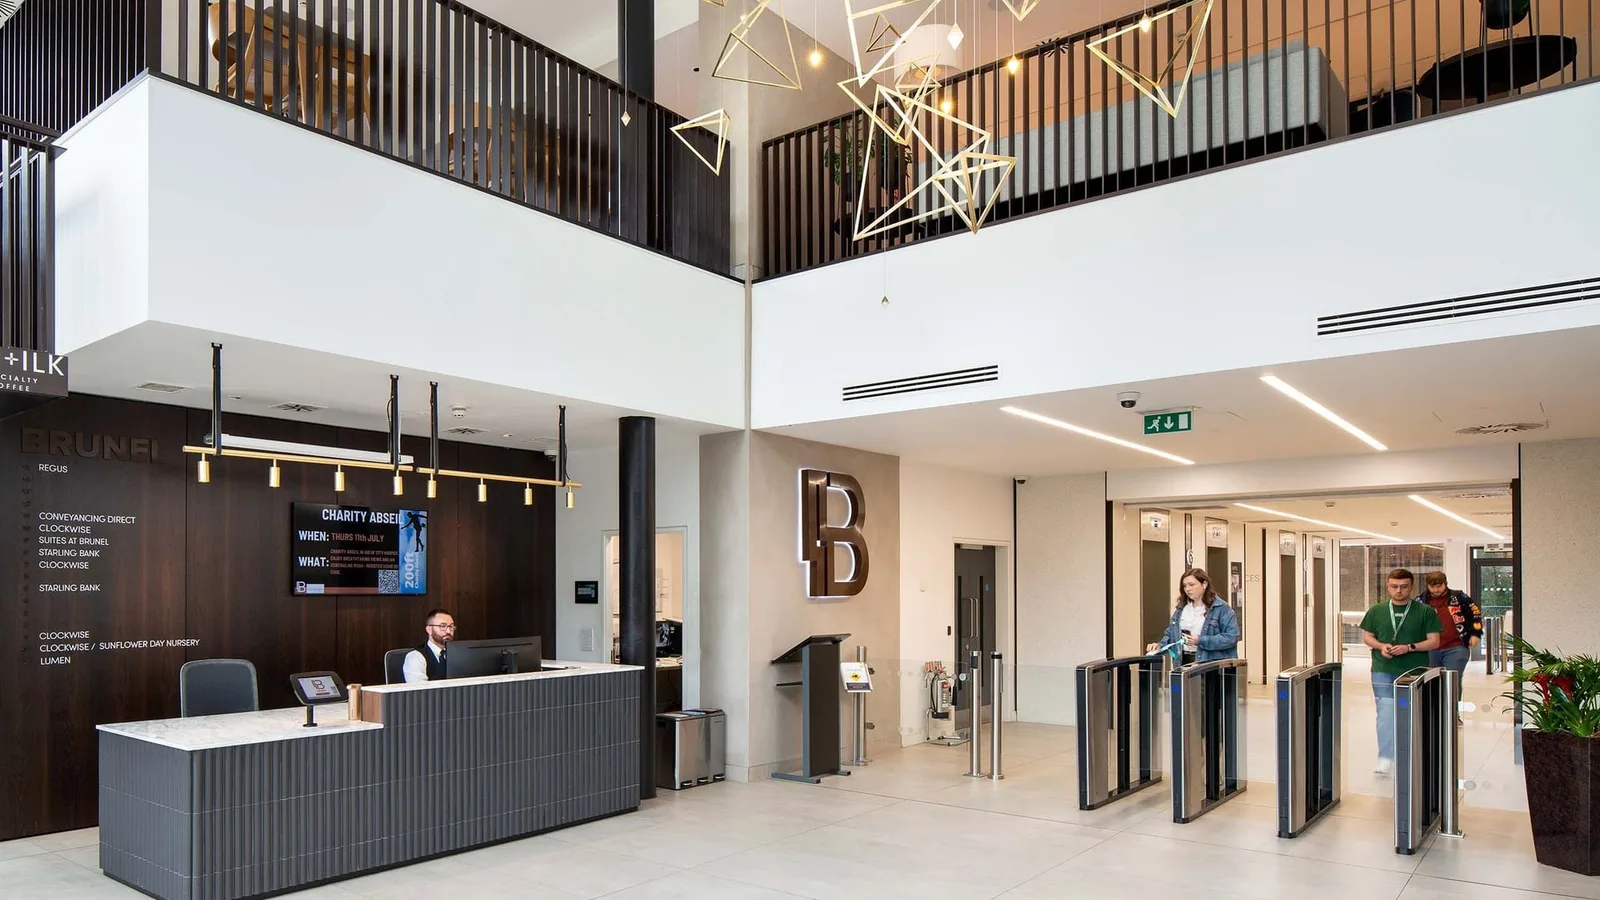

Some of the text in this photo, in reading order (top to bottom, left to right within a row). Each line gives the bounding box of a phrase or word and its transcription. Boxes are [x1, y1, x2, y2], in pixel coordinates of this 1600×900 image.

[39, 463, 68, 474] REGUS
[39, 512, 136, 524] CONVEYANCING DIRECT
[322, 508, 404, 525] CHARITY ABSEIL
[39, 524, 91, 534] CLOCKWISE
[39, 536, 109, 546] SUITES AT BRUNEL
[298, 530, 330, 541] WHEN:
[331, 532, 354, 541] THURS
[367, 534, 385, 542] JULY
[39, 548, 100, 558] STARLING BANK
[39, 561, 89, 570] CLOCKWISE
[298, 556, 329, 567] WHAT:
[39, 583, 100, 592] STARLING BANK
[39, 631, 89, 640] CLOCKWISE
[40, 643, 89, 653] CLOCKWISE
[99, 640, 148, 650] SUNFLOWER
[150, 640, 165, 648] DAY
[166, 638, 200, 647] NURSERY
[40, 656, 71, 666] LUMEN
